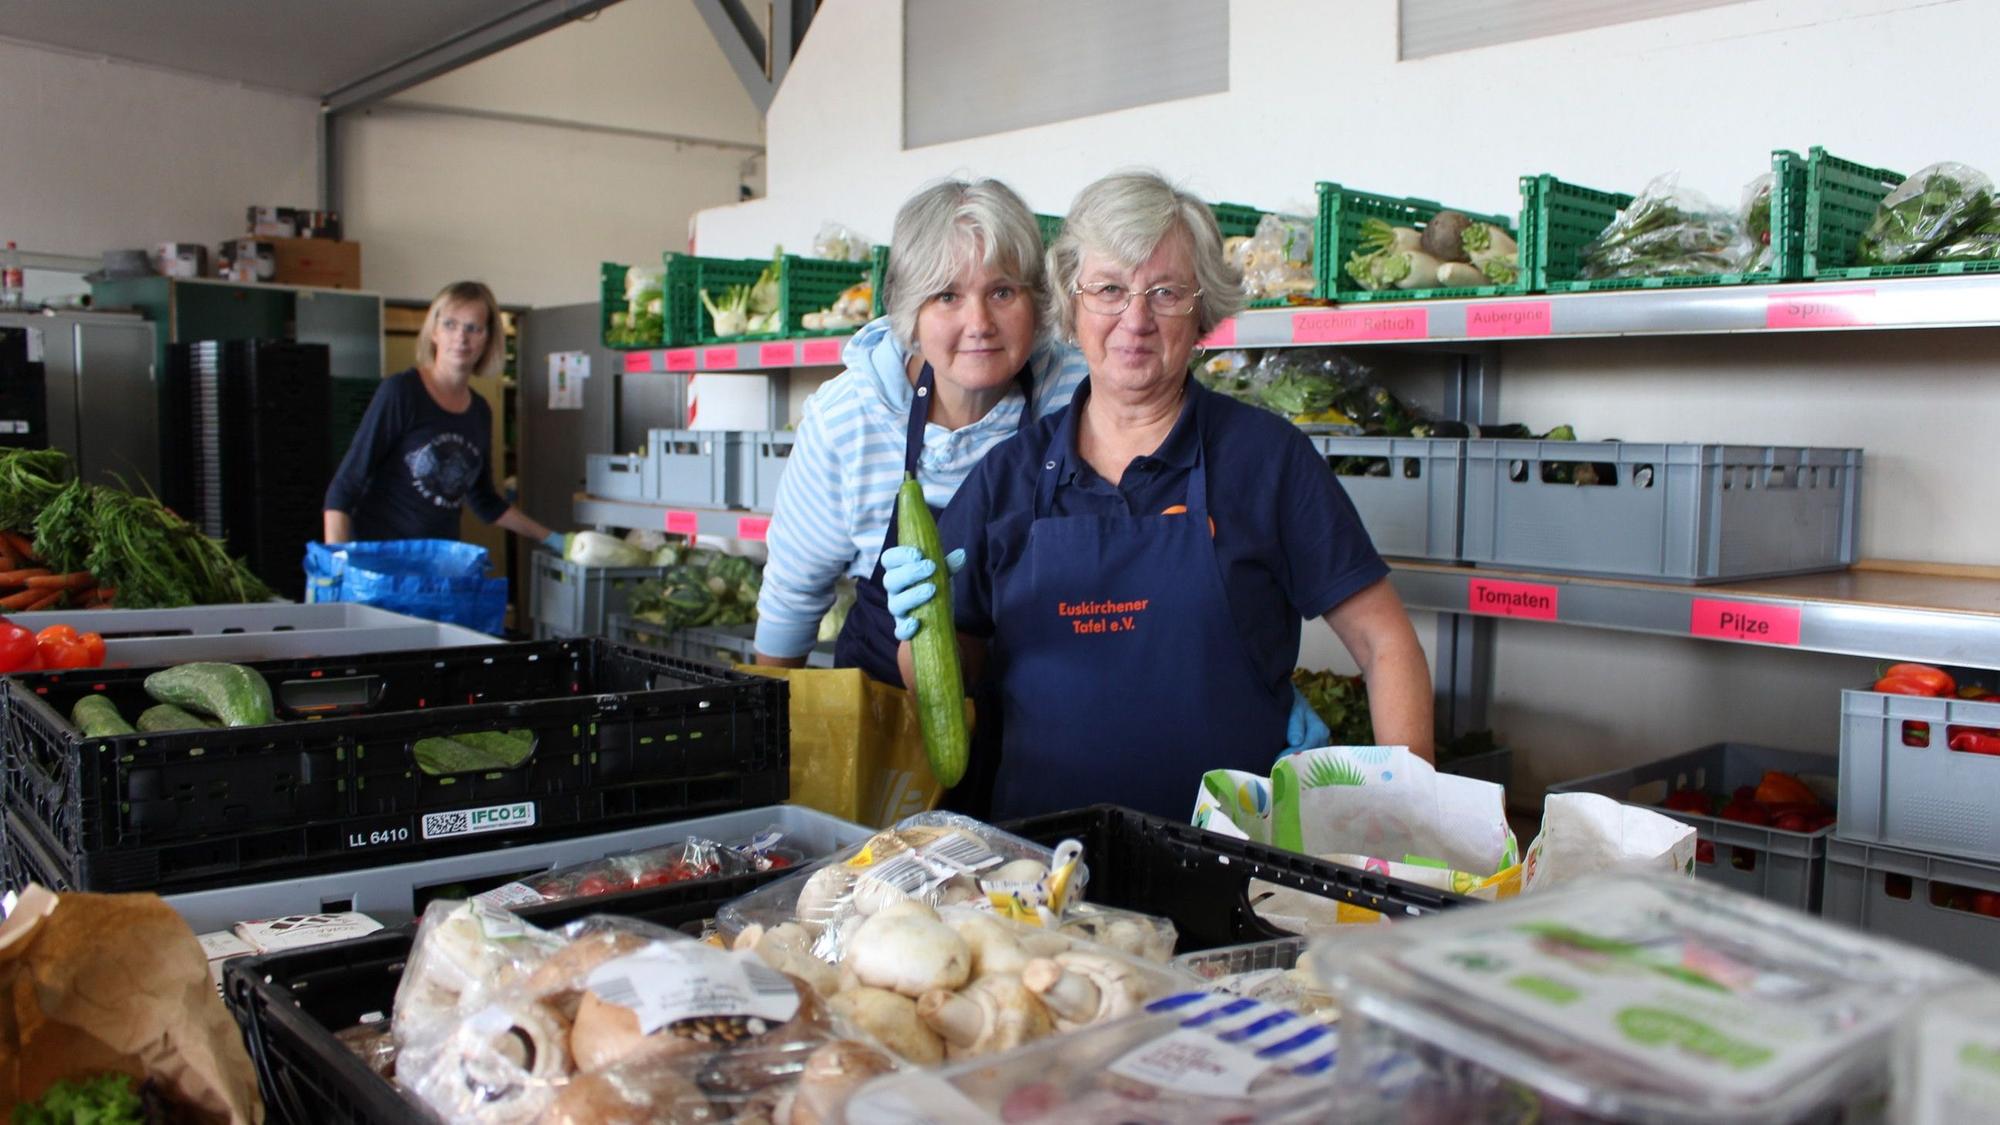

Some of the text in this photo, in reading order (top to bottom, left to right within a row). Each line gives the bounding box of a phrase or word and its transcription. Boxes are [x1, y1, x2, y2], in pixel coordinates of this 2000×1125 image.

[1298, 315, 1415, 331] Zucchini Rettich
[1473, 310, 1543, 325] Aubergine
[1476, 586, 1550, 609] Tomaten
[1058, 600, 1149, 617] Euskirchener
[1073, 617, 1135, 634] Tafel e.V.
[1719, 612, 1770, 635] Pilze
[471, 807, 511, 825] IFCO
[350, 828, 409, 848] LL 6410
